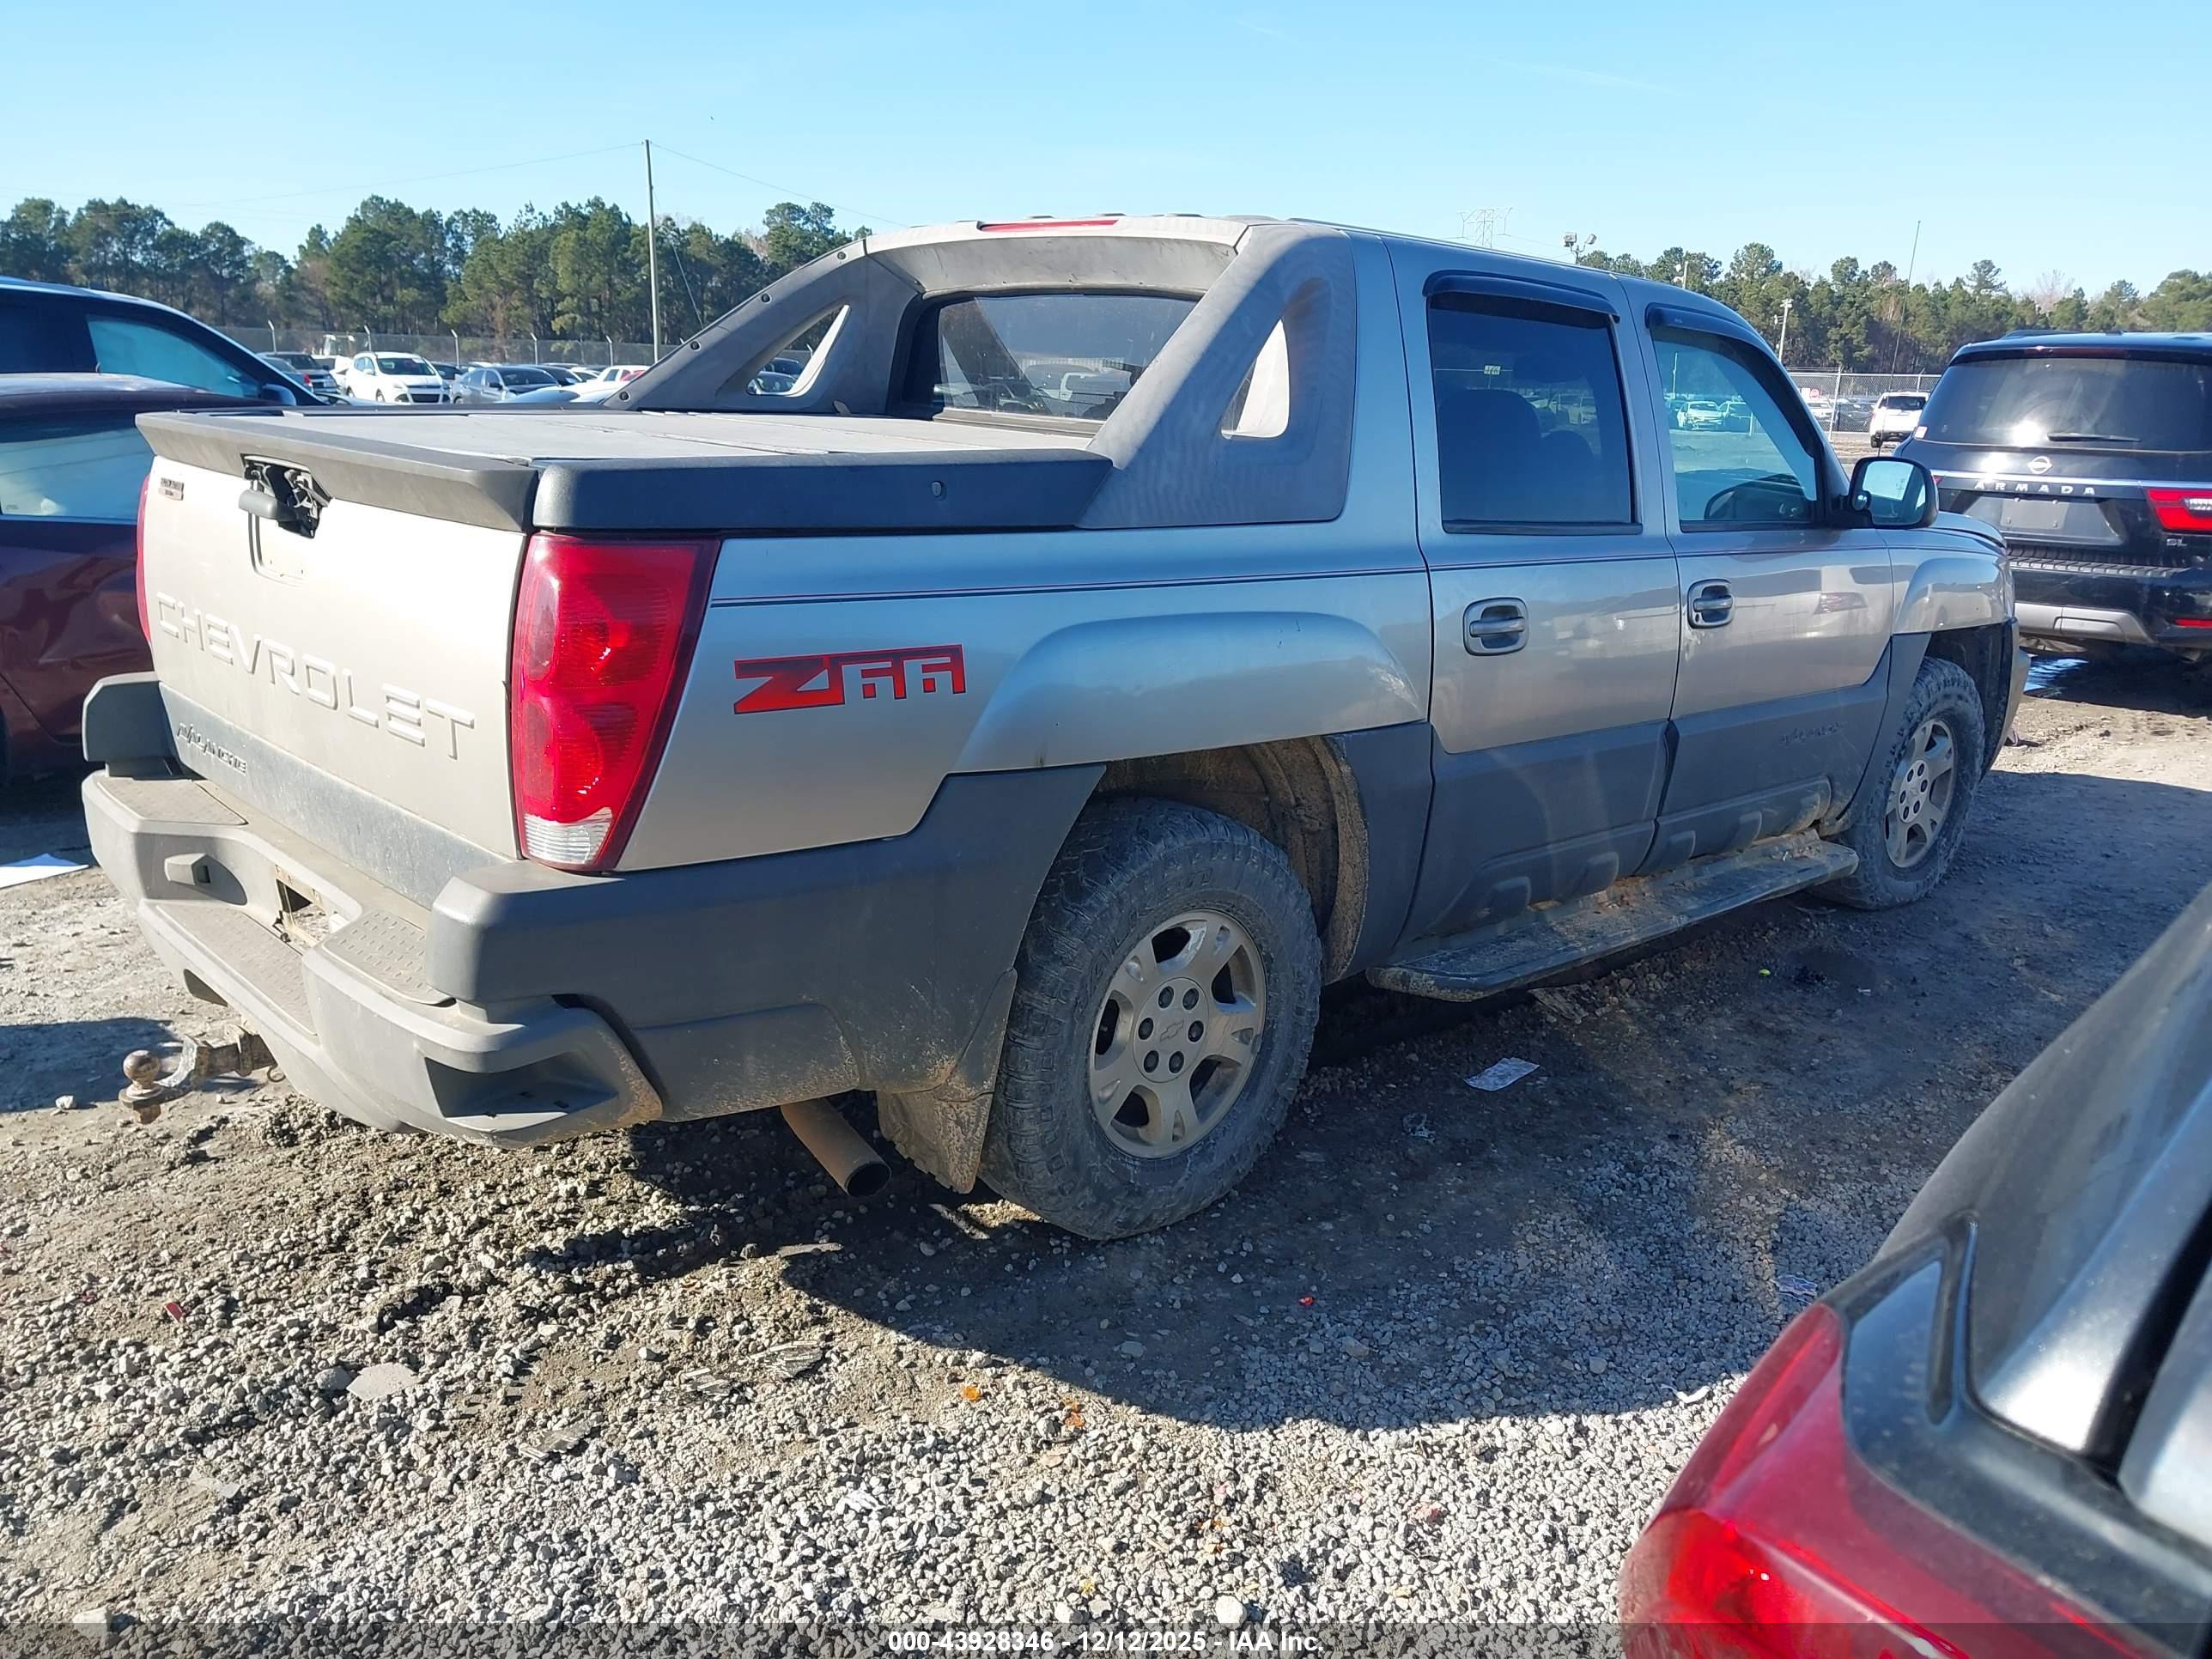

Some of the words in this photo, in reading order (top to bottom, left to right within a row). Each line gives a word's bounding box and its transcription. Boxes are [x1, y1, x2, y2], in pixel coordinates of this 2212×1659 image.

[1974, 481, 2096, 495] ARMADA
[156, 592, 476, 760] CHEVROLET
[176, 722, 247, 777] AVALANCHE
